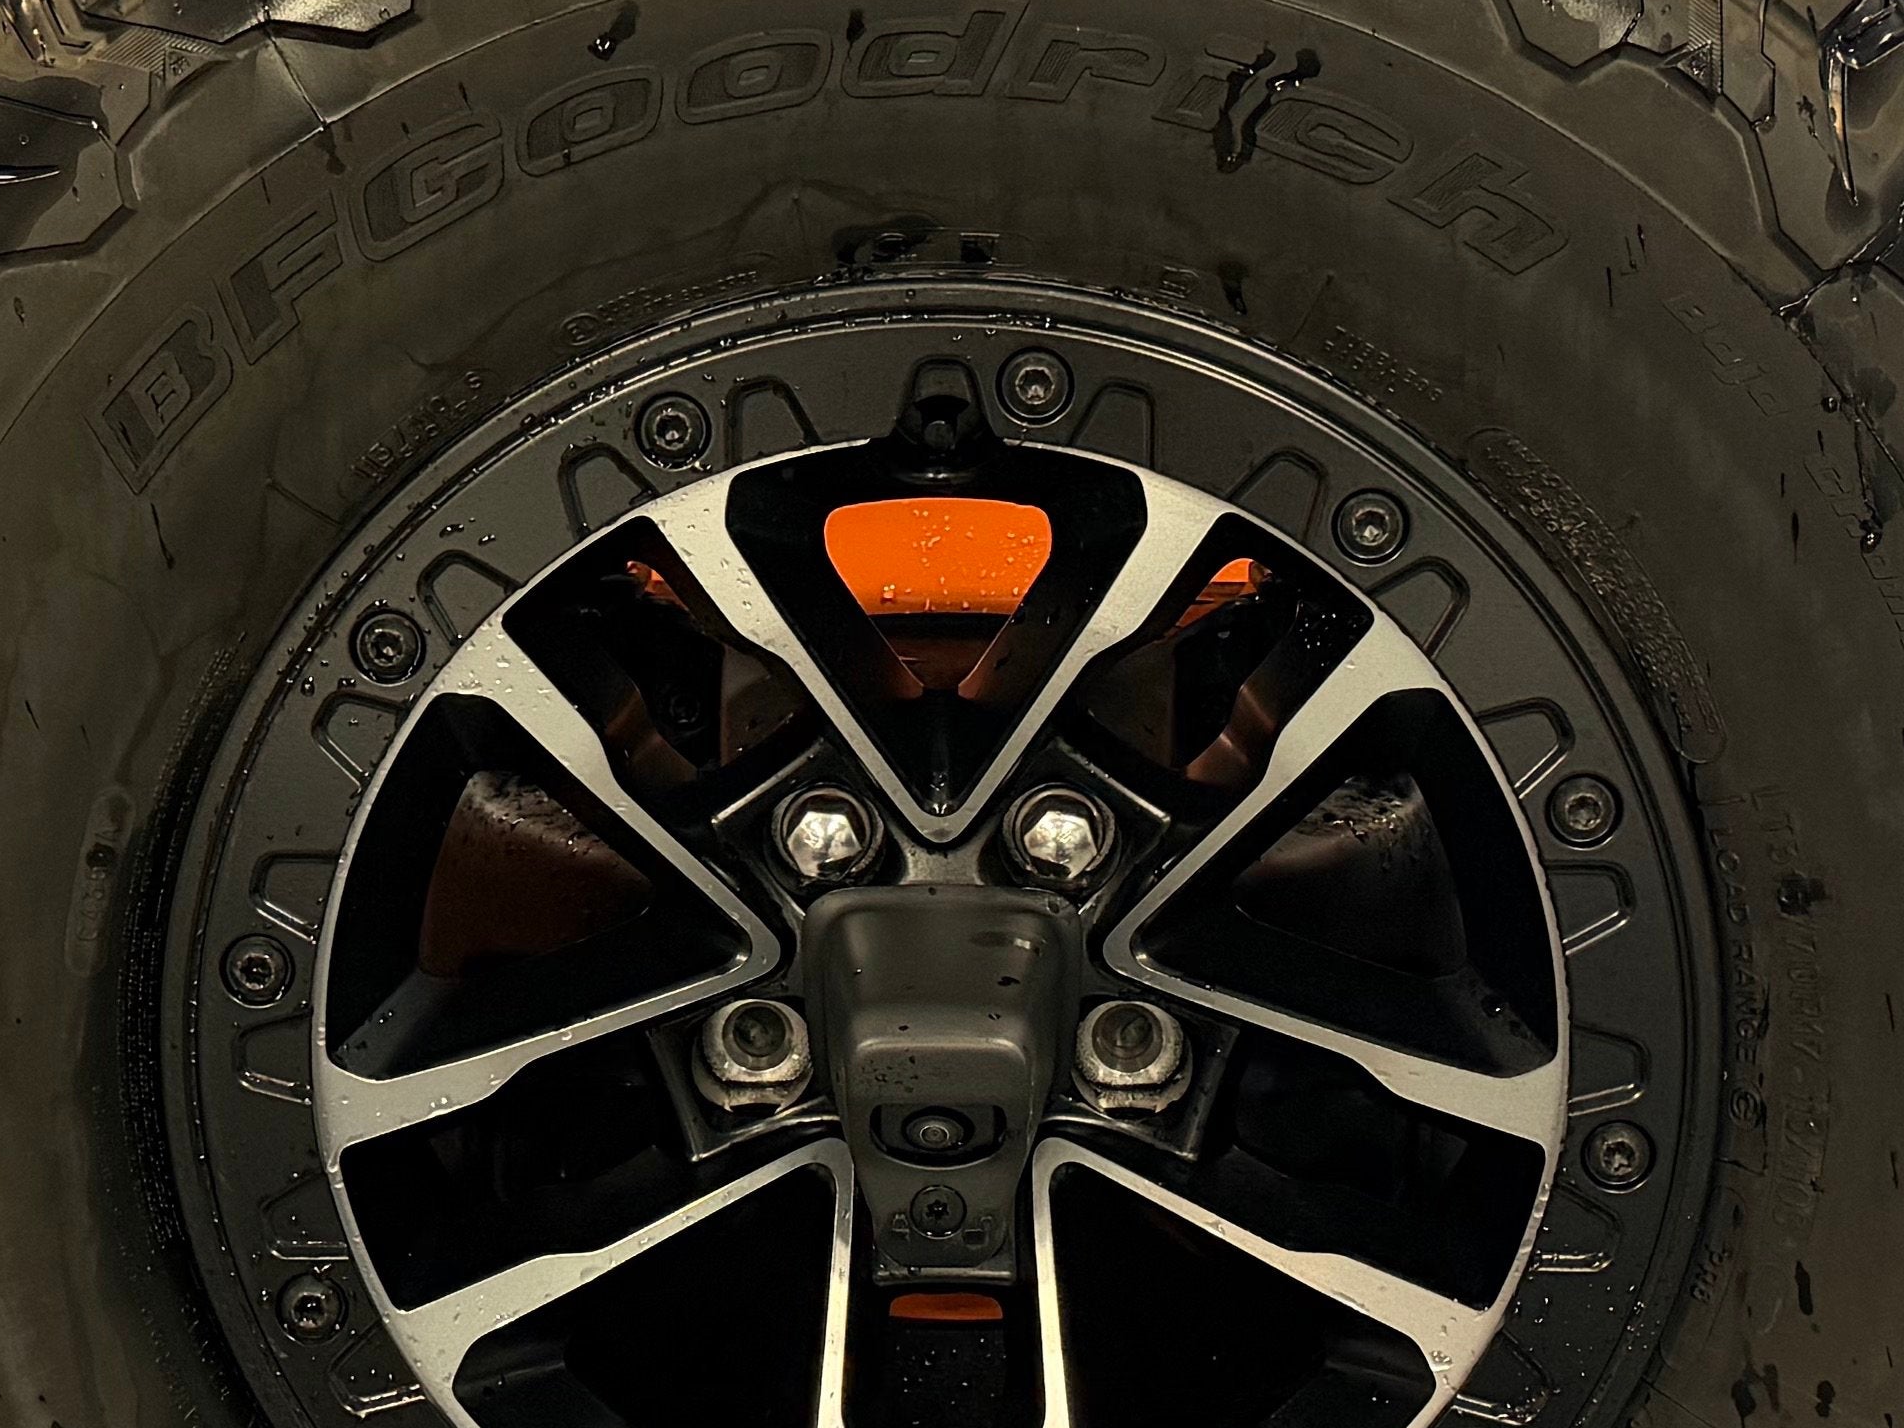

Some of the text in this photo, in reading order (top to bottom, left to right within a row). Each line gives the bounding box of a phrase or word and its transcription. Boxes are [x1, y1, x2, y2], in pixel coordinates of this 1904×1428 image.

[83, 2, 1570, 493] BFGoodrich
[1662, 294, 1791, 418] Baja
[1708, 823, 1752, 928] LOAD
[1728, 936, 1760, 1065] RANGE
